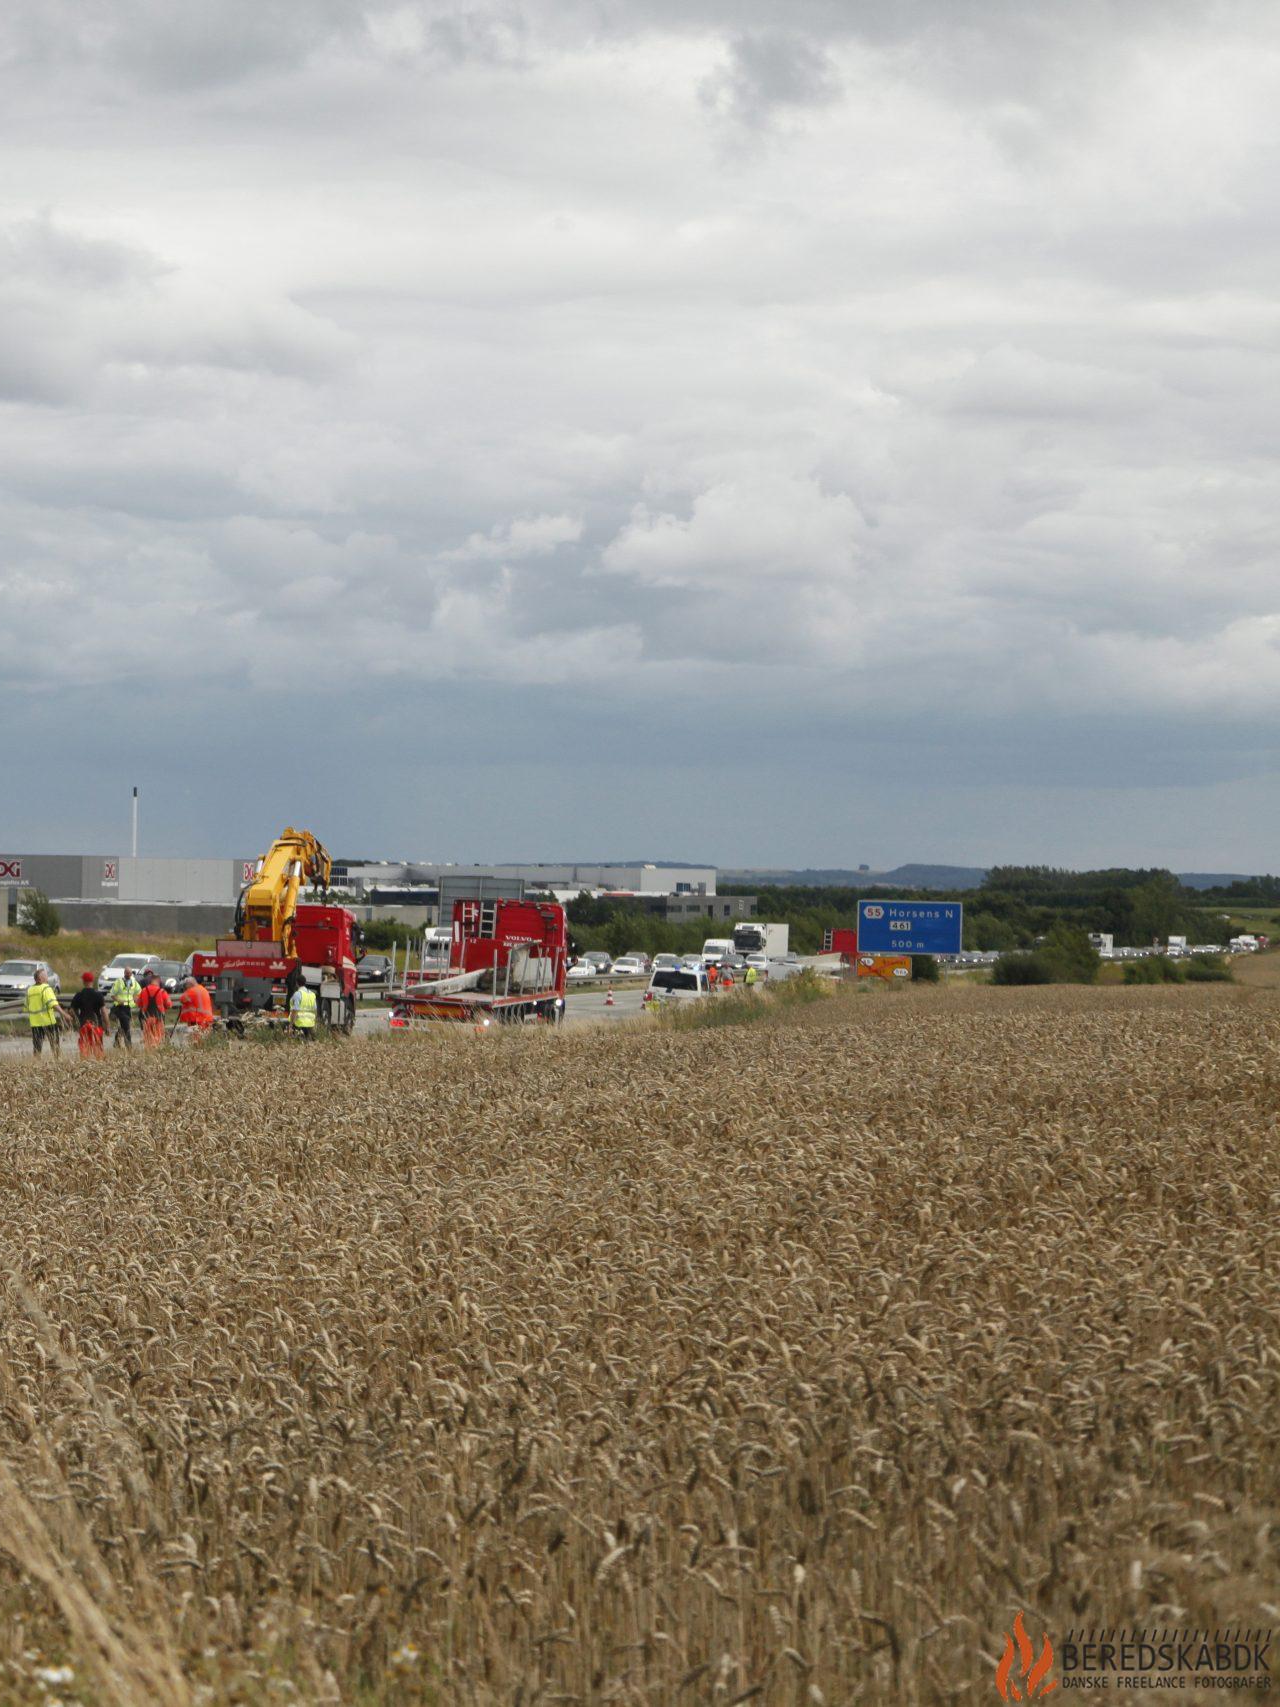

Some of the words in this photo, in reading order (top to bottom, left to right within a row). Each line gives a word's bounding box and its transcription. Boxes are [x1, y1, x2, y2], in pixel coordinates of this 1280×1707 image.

[867, 908, 881, 917] 55
[889, 908, 940, 918] Horsens
[945, 909, 953, 918] N
[892, 923, 910, 931] 461
[891, 939, 912, 948] 500
